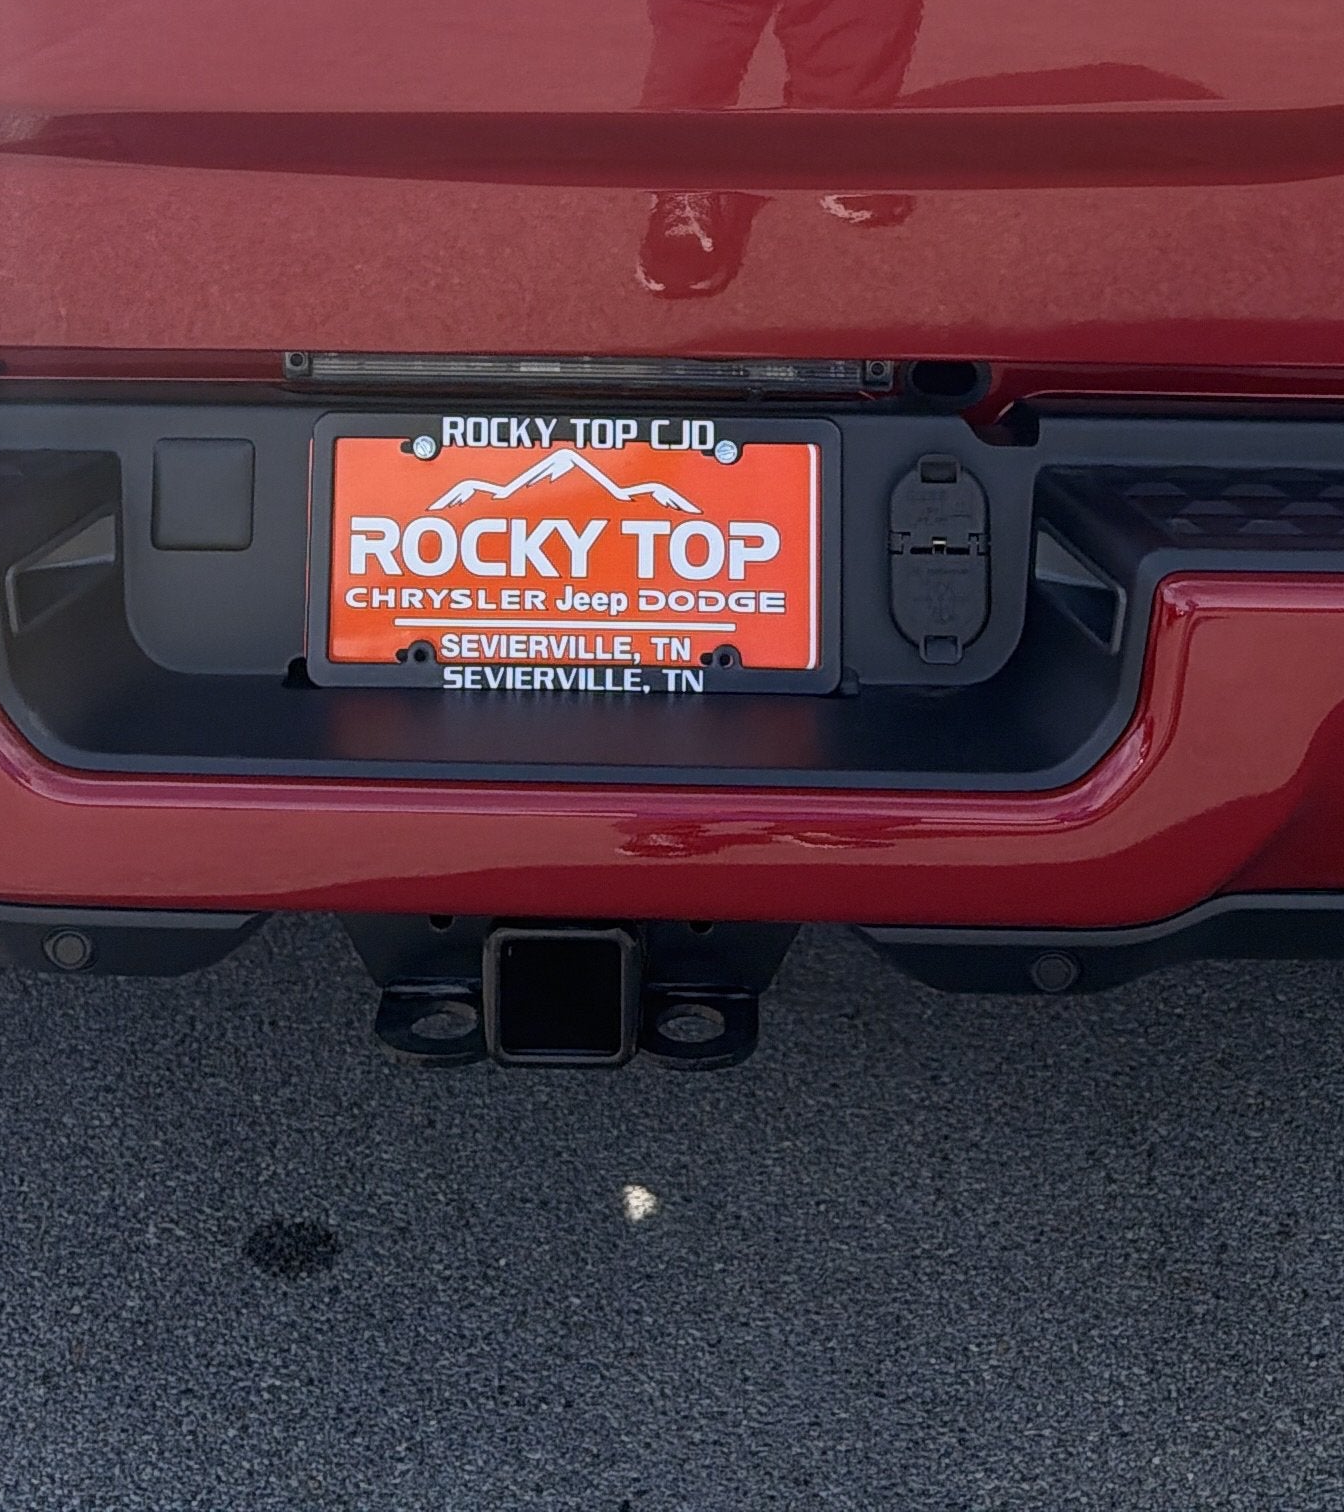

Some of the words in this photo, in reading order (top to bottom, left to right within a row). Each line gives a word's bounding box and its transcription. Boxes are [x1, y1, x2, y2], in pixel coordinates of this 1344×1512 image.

[441, 416, 558, 449] ROCKY
[571, 418, 638, 450] TOP
[650, 420, 715, 452] CJD
[349, 516, 609, 578] ROCKY
[621, 520, 782, 582] TOP
[345, 587, 547, 611] CHRYSLER
[555, 585, 628, 616] Jeep
[638, 590, 786, 614] DODGE
[440, 633, 641, 664] SEVIERVILLE,
[651, 636, 691, 662] TN
[442, 666, 651, 694] SEVIERVILLE,
[661, 669, 704, 693] TN
